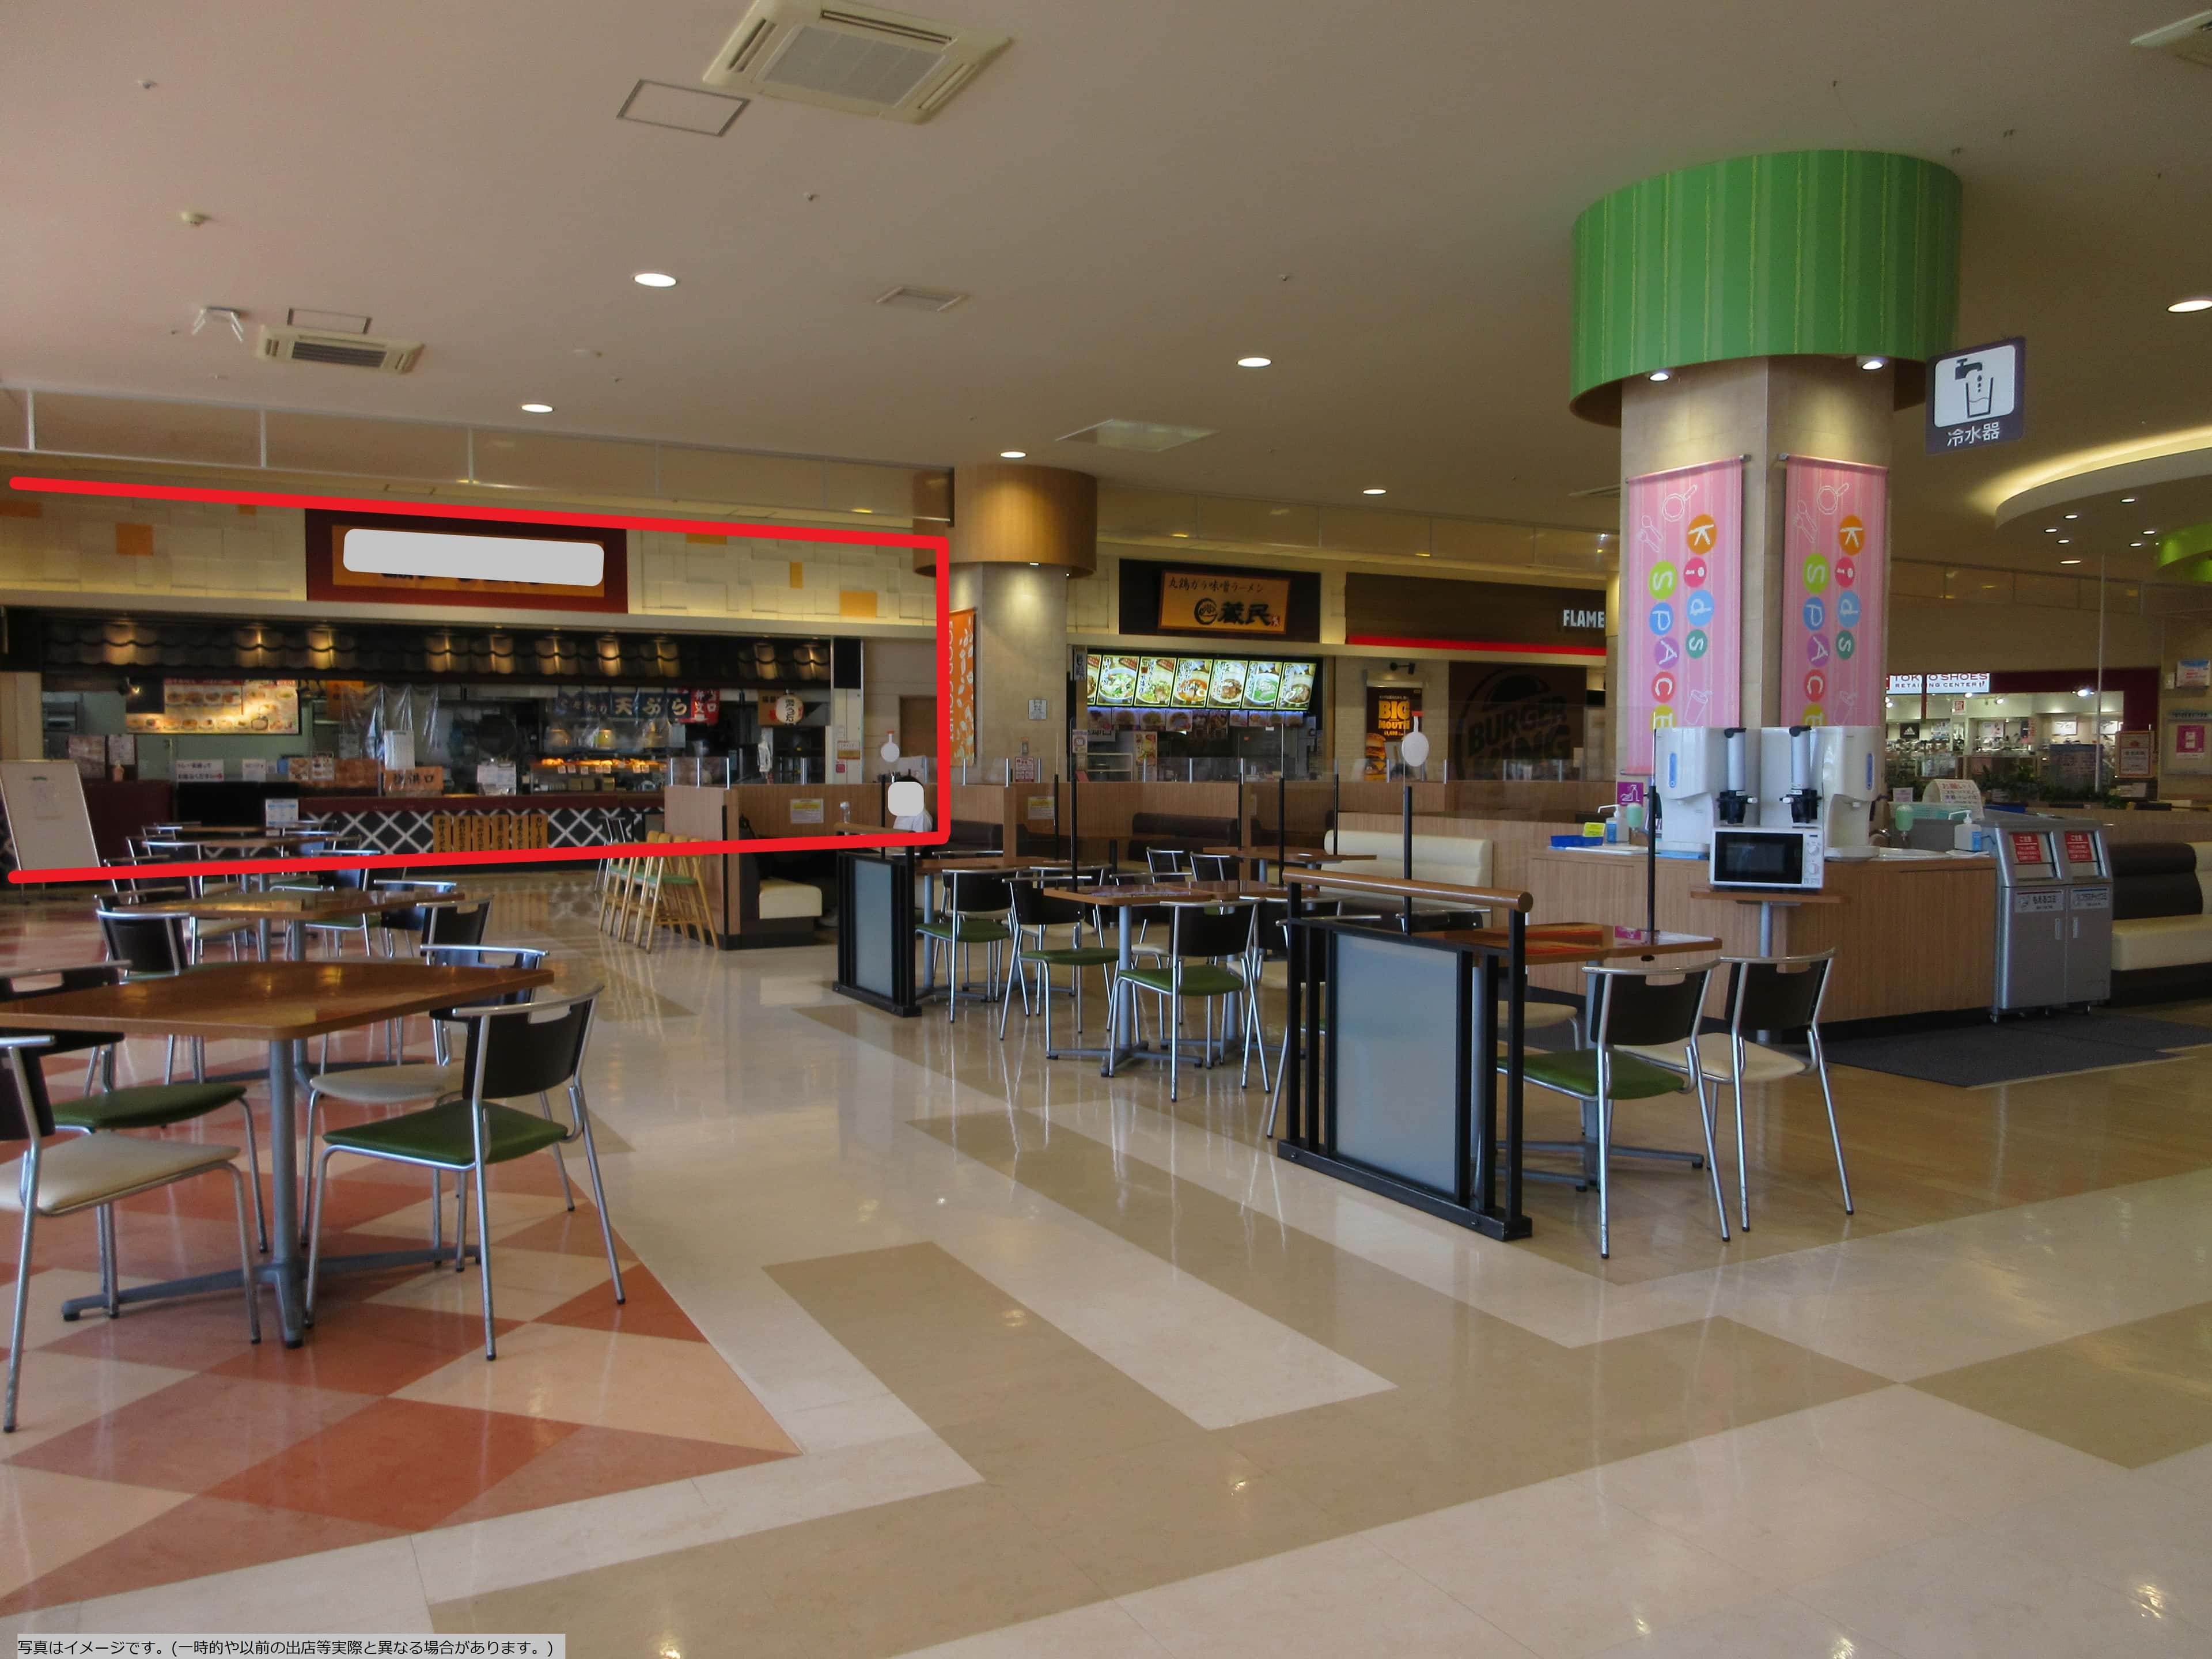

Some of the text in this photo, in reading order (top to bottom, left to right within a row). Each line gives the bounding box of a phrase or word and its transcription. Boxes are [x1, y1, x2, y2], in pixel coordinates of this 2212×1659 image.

[1946, 421, 2001, 447] 冷水器
[1169, 576, 1263, 593] 丸鶏ガラ味噌ラーメン
[1563, 609, 1605, 628] FLAME
[1940, 673, 1988, 681] SHOES
[1378, 700, 1410, 719] BIG
[1378, 720, 1410, 729] MOUTH
